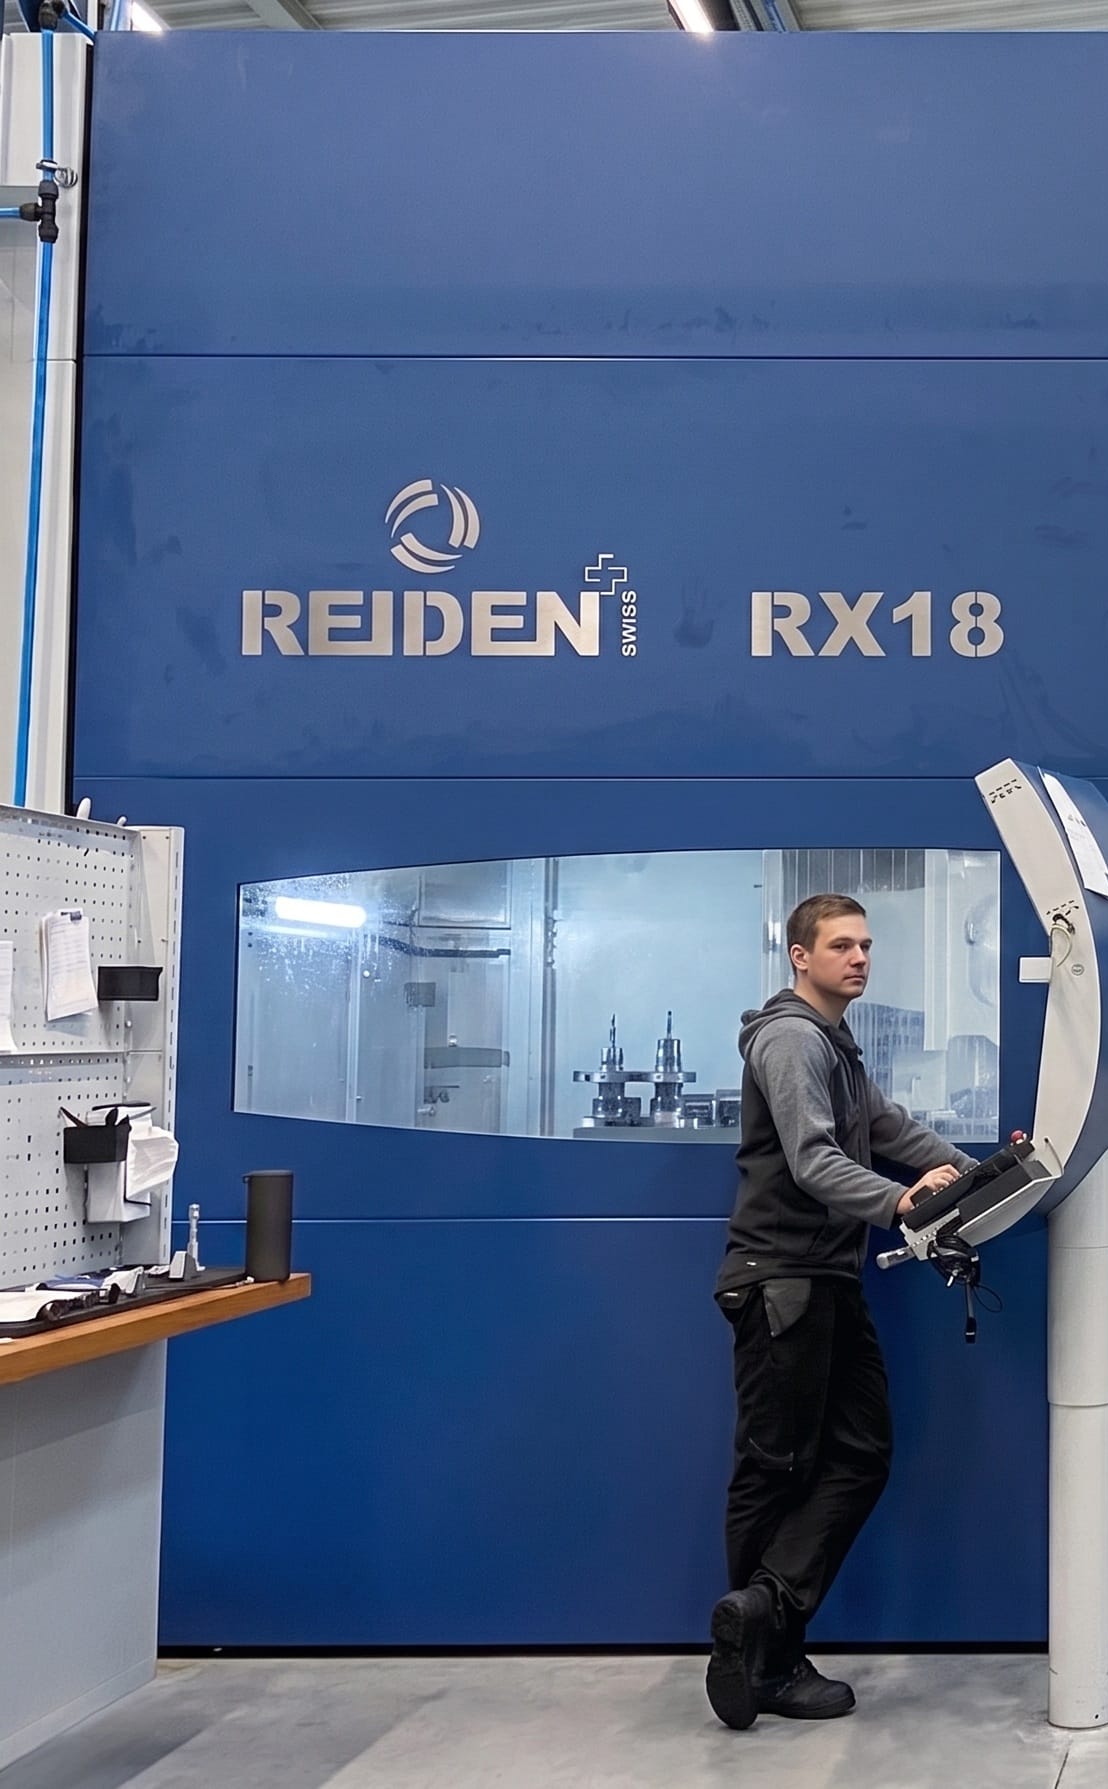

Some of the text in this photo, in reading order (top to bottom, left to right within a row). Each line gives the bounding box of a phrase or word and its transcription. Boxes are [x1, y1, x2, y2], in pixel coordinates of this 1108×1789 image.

[241, 590, 600, 657] REIDEN
[621, 590, 638, 657] SWISS
[751, 591, 1004, 657] RX18
